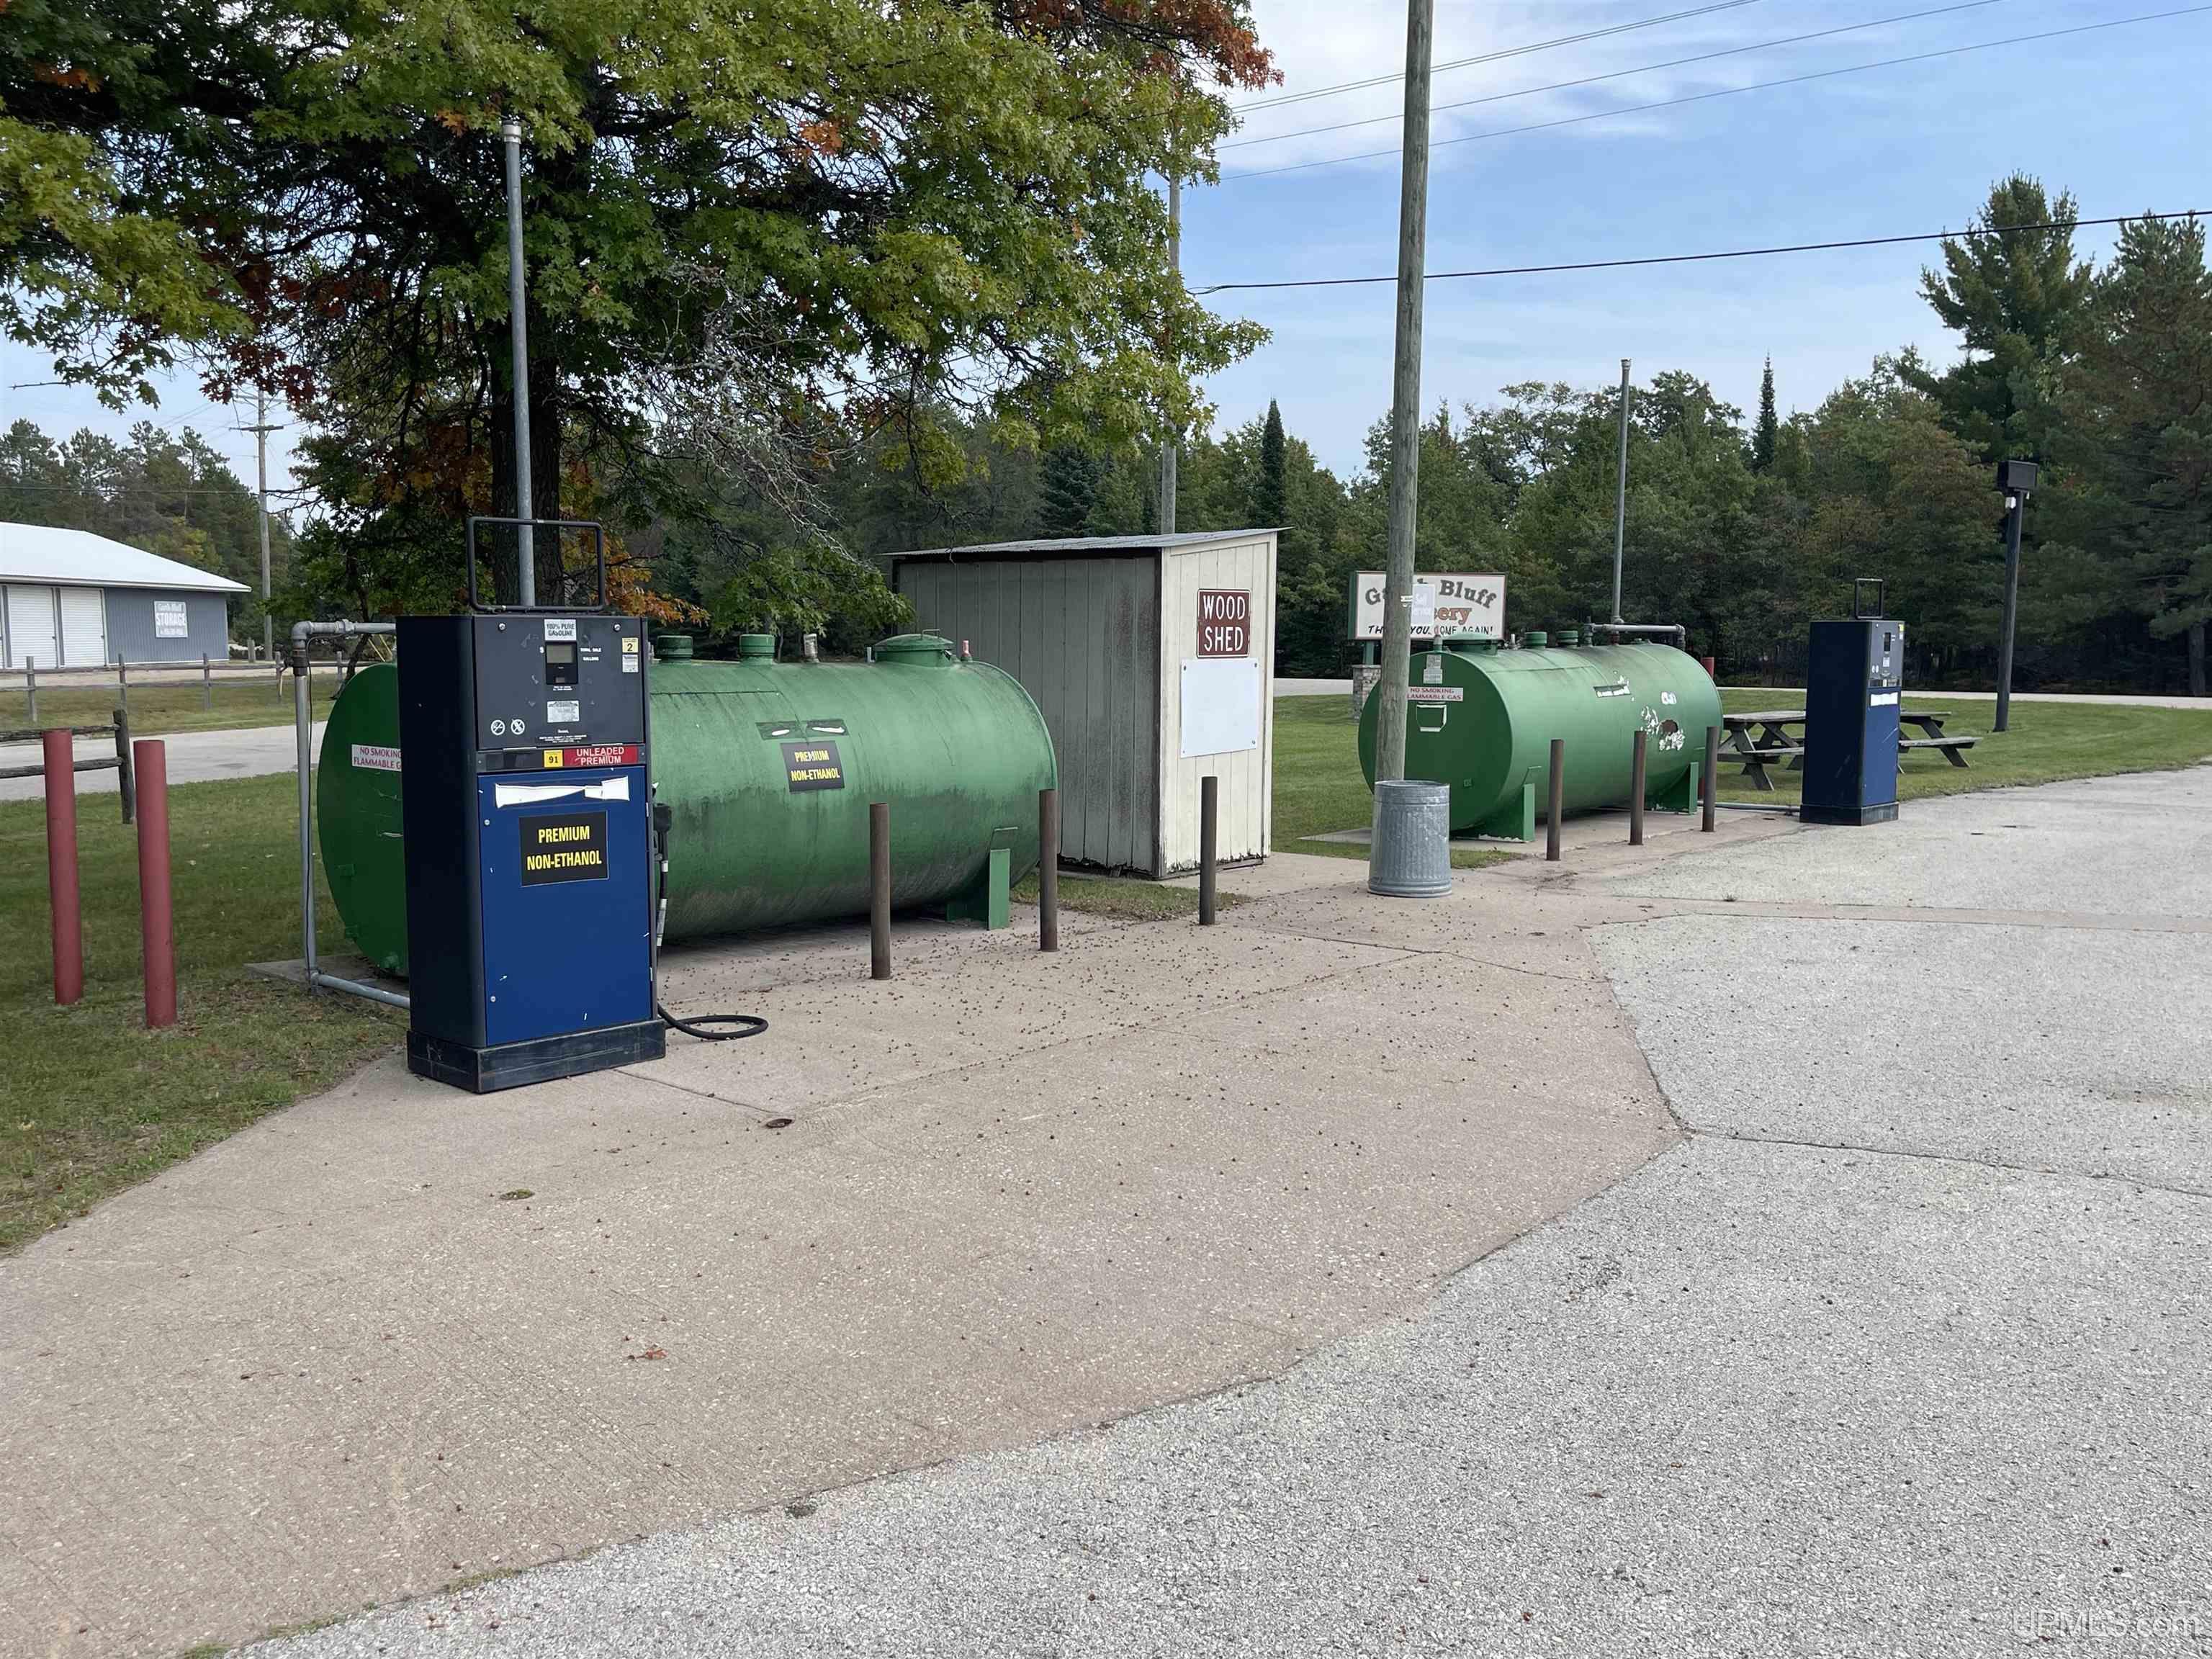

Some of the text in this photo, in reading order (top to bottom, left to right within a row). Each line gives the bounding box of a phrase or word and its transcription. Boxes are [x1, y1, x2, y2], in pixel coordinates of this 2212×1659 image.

[1439, 579, 1497, 608] Bluff
[1203, 595, 1246, 620] WOOD
[156, 612, 185, 626] STORAGE
[1204, 626, 1244, 652] SHED
[627, 643, 633, 652] 2
[359, 747, 369, 755] NO
[576, 747, 625, 757] UNLEADED
[794, 749, 830, 763] PREMIUM
[353, 756, 395, 769] FLAMMABLE
[581, 755, 621, 765] PREMIUM
[791, 768, 841, 782] NON-ETHANOL
[538, 825, 590, 843] PREMIUM
[526, 850, 602, 871] NON-ETHANOL
